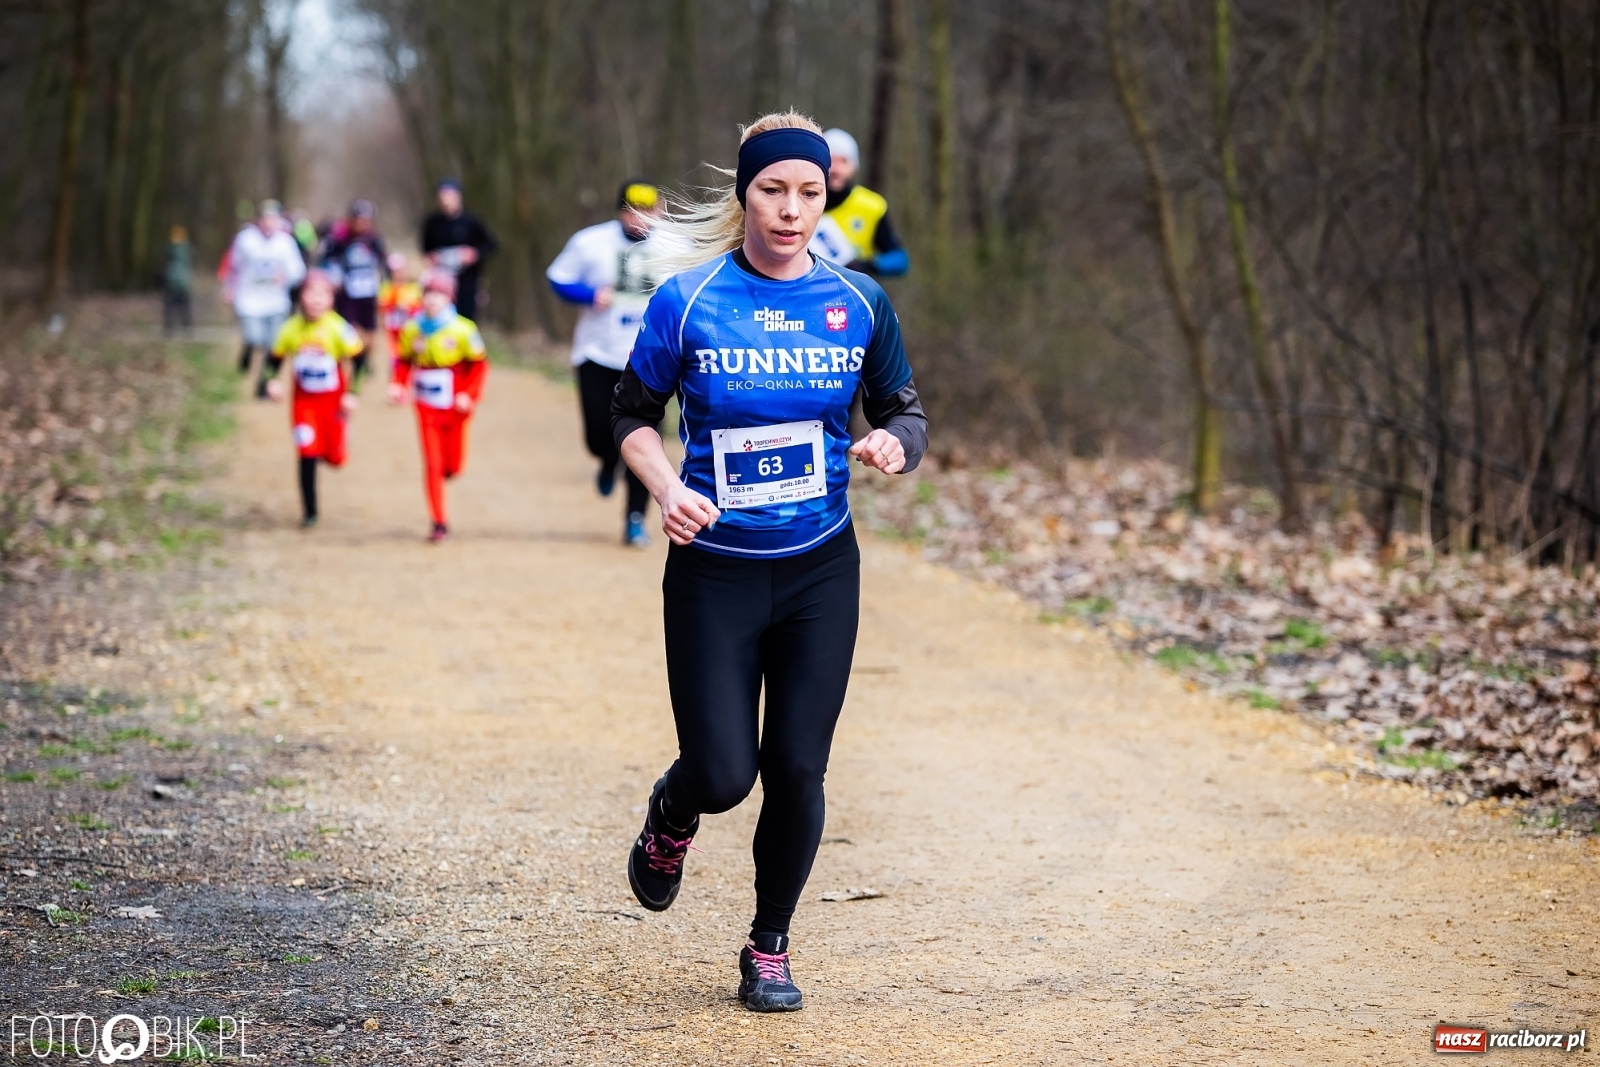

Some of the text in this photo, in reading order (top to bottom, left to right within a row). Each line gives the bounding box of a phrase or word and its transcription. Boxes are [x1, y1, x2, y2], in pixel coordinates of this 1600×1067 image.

[753, 306, 786, 322] eko
[764, 320, 805, 332] okna
[695, 346, 866, 375] RUNNERS
[808, 379, 843, 389] TEAM
[758, 456, 784, 477] 63
